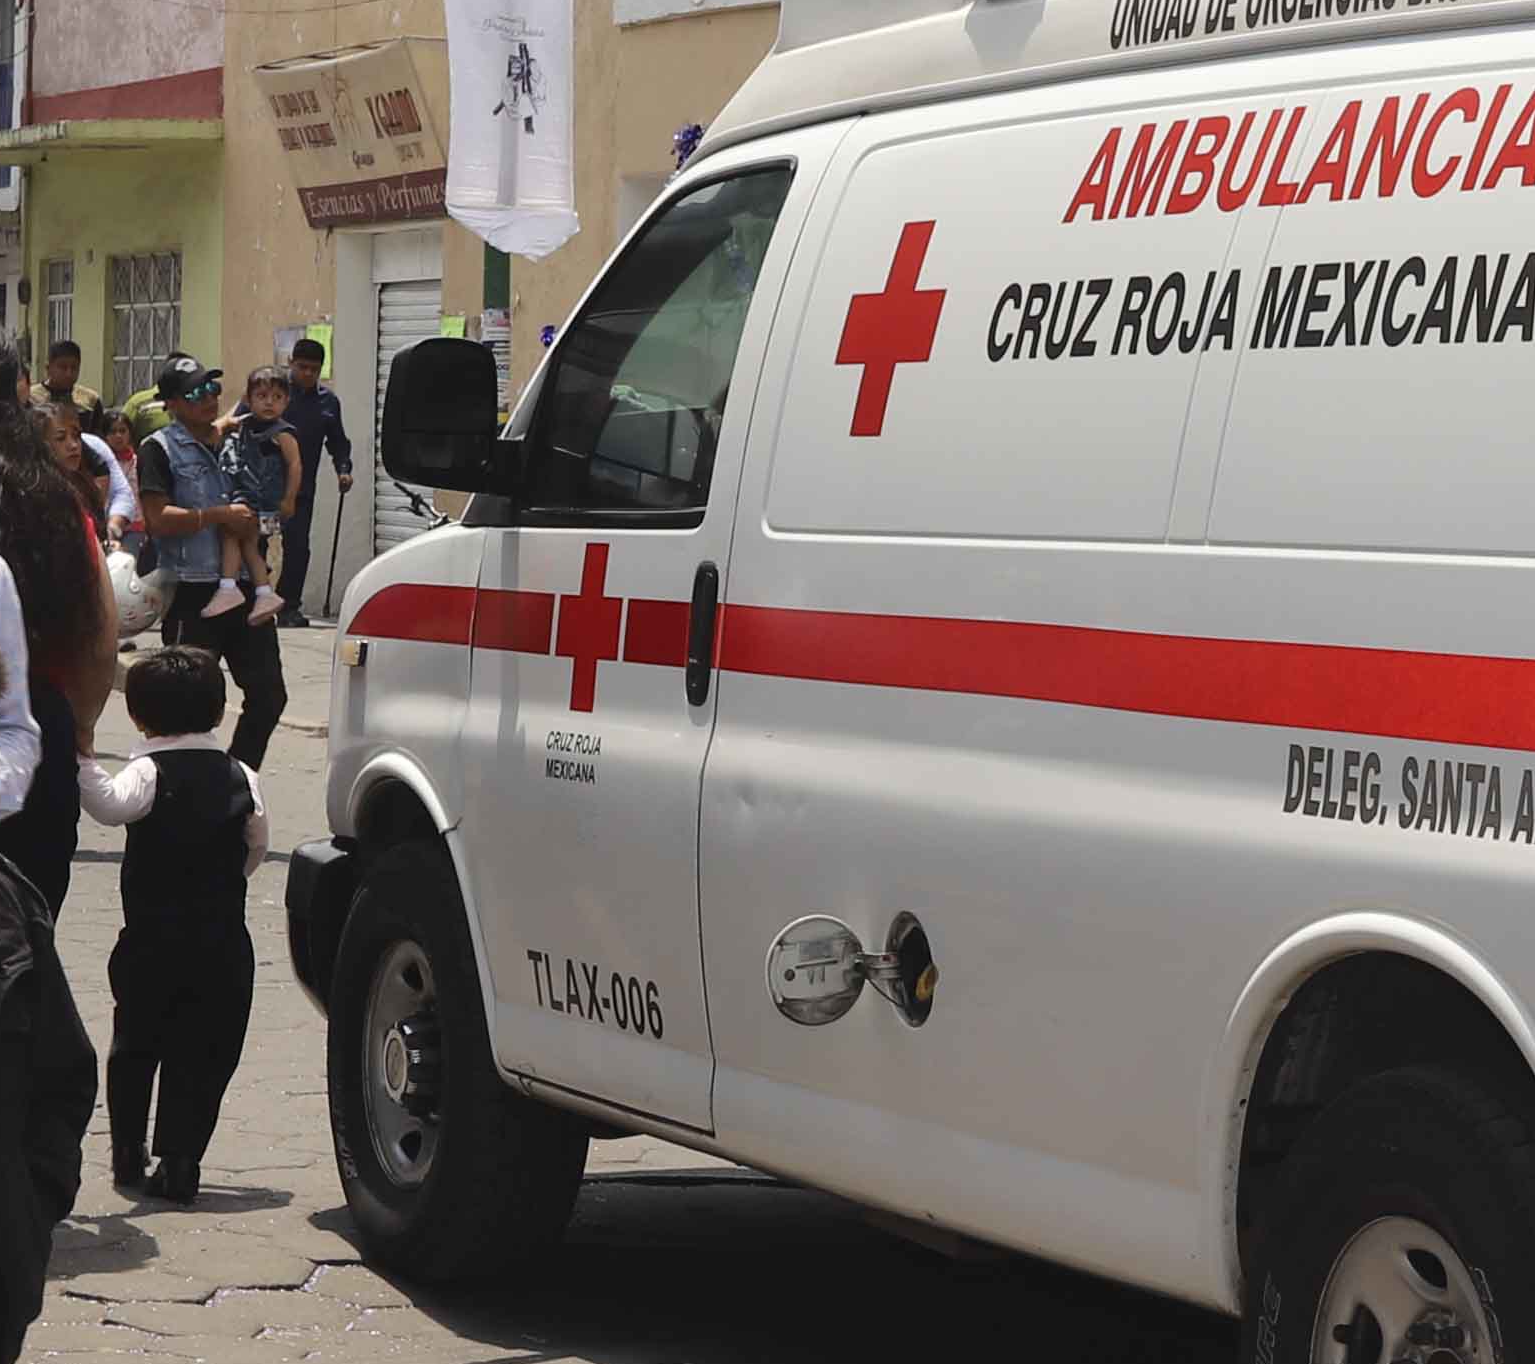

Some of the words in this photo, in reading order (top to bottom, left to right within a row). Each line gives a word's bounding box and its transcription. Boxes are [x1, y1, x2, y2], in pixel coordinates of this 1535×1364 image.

[304, 190, 364, 219] Esencias
[987, 278, 1111, 362] CRUZ
[1111, 267, 1239, 355] ROJA
[545, 730, 575, 755] CRUZ
[575, 733, 602, 757] ROJA
[545, 758, 596, 784] MEXICANA
[1283, 744, 1389, 826] DELEG.
[1398, 756, 1502, 840] SANTA
[526, 948, 664, 1040] TLAX-006
